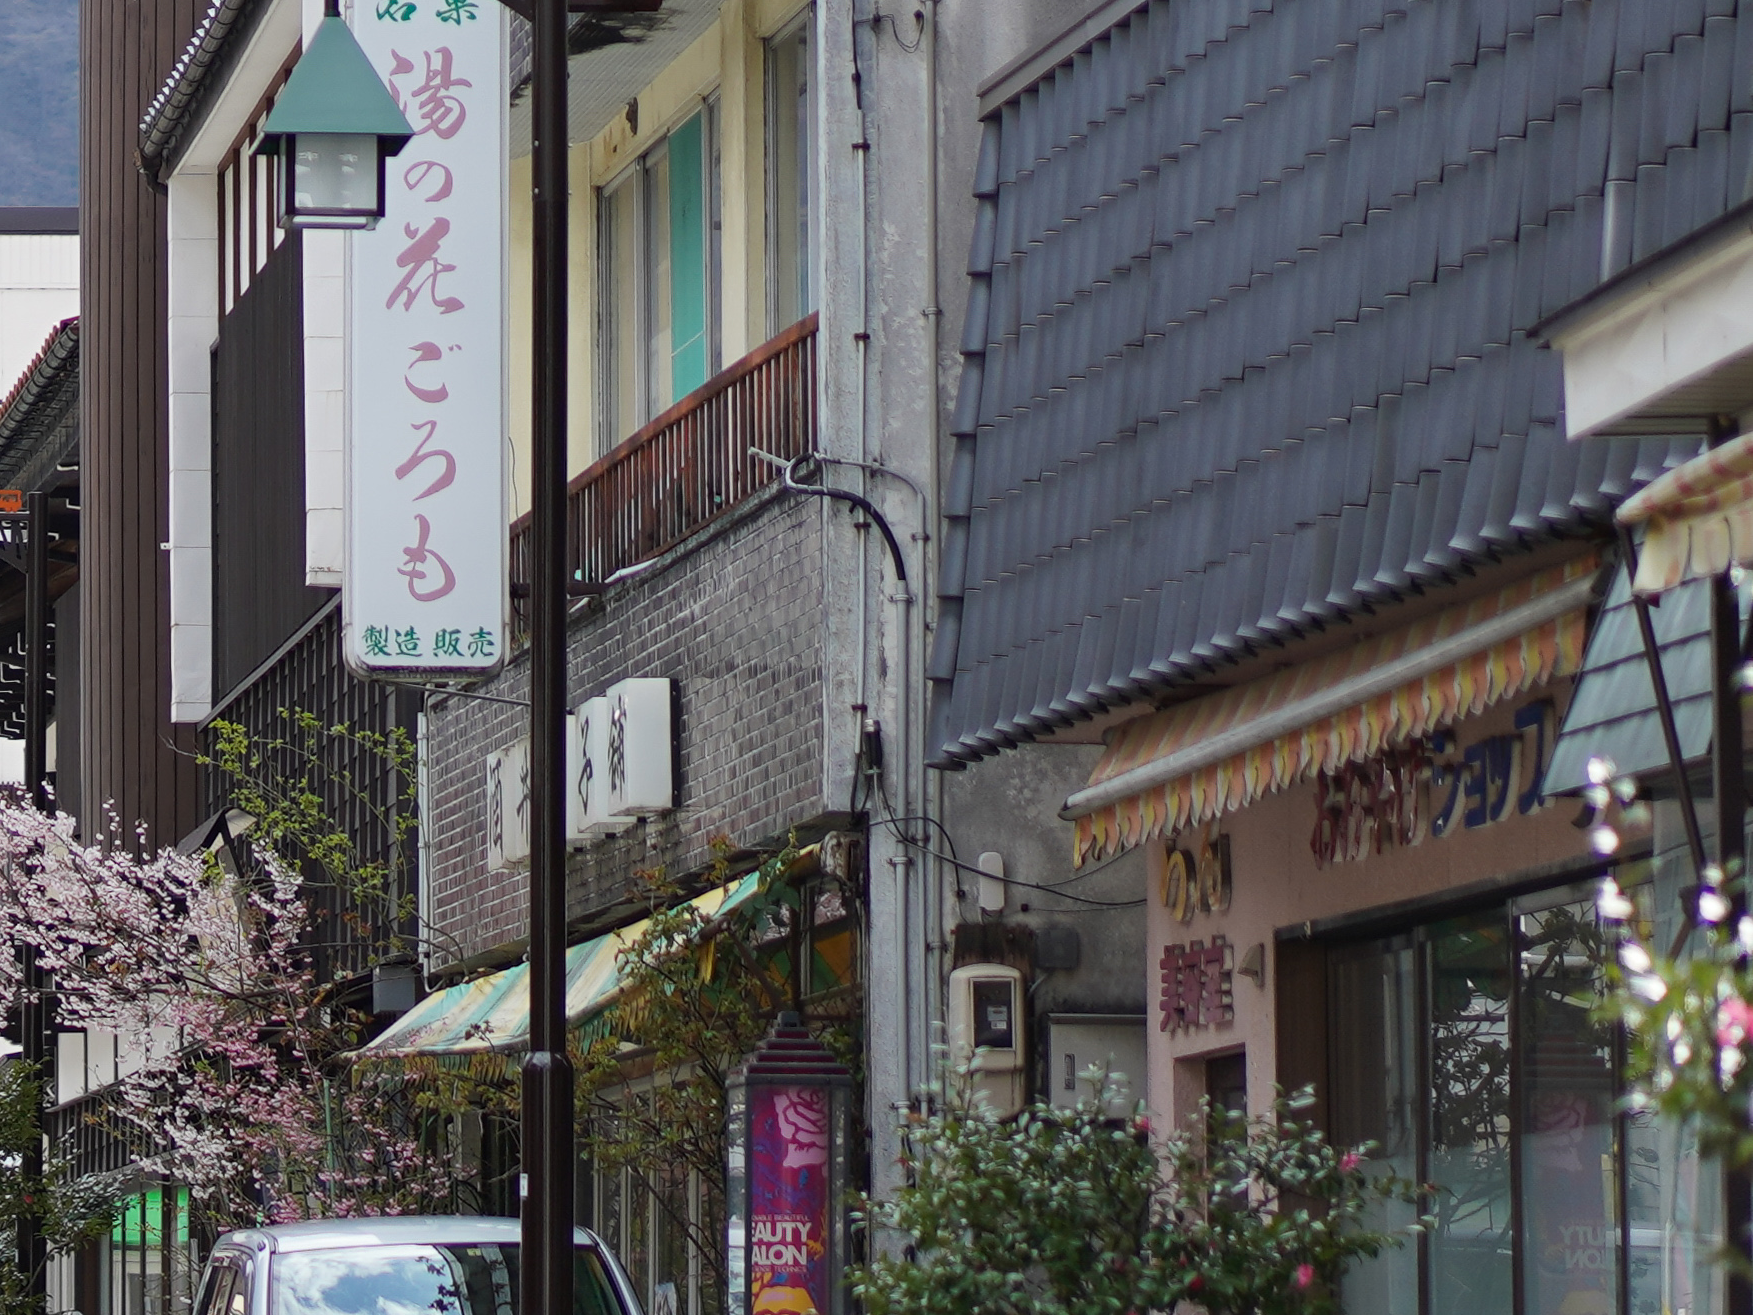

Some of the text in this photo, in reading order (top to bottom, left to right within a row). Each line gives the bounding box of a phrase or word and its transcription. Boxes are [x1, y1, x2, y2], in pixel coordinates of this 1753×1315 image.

[385, 47, 473, 602] 湯の花ごろも
[751, 1221, 812, 1243] AUTY
[751, 1243, 808, 1266] ALON
